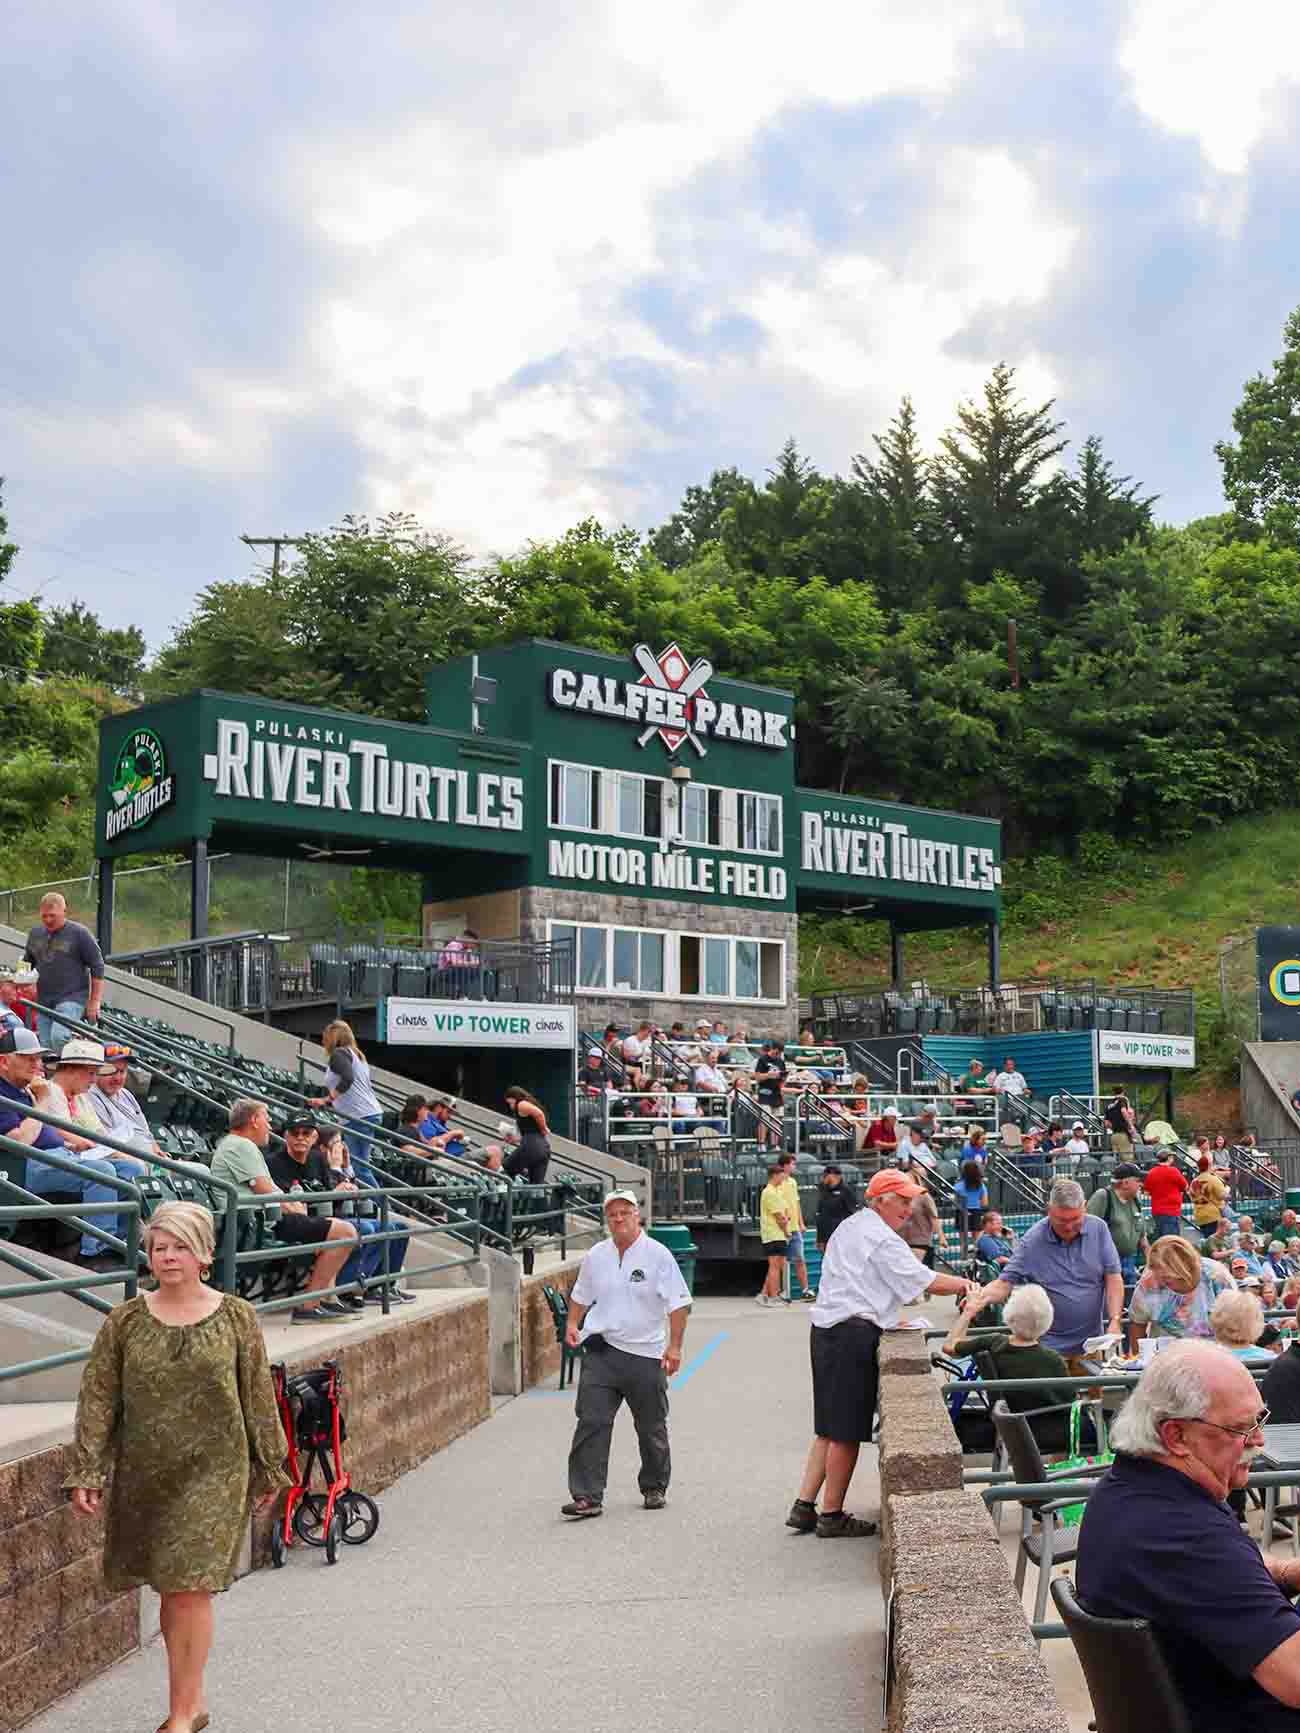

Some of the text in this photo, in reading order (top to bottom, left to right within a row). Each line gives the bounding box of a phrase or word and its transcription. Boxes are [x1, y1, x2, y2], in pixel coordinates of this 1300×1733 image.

[552, 668, 788, 747] CALFEE PARK
[255, 719, 344, 745] PULASKI
[134, 733, 161, 776] PULASKI
[823, 810, 881, 828] PULASKI
[548, 839, 787, 900] MOTOR MILE FIELD
[434, 1014, 463, 1031] VIP
[468, 1016, 531, 1034] TOWER
[1124, 1042, 1140, 1055] VIP
[1141, 1043, 1173, 1057] TOWER
